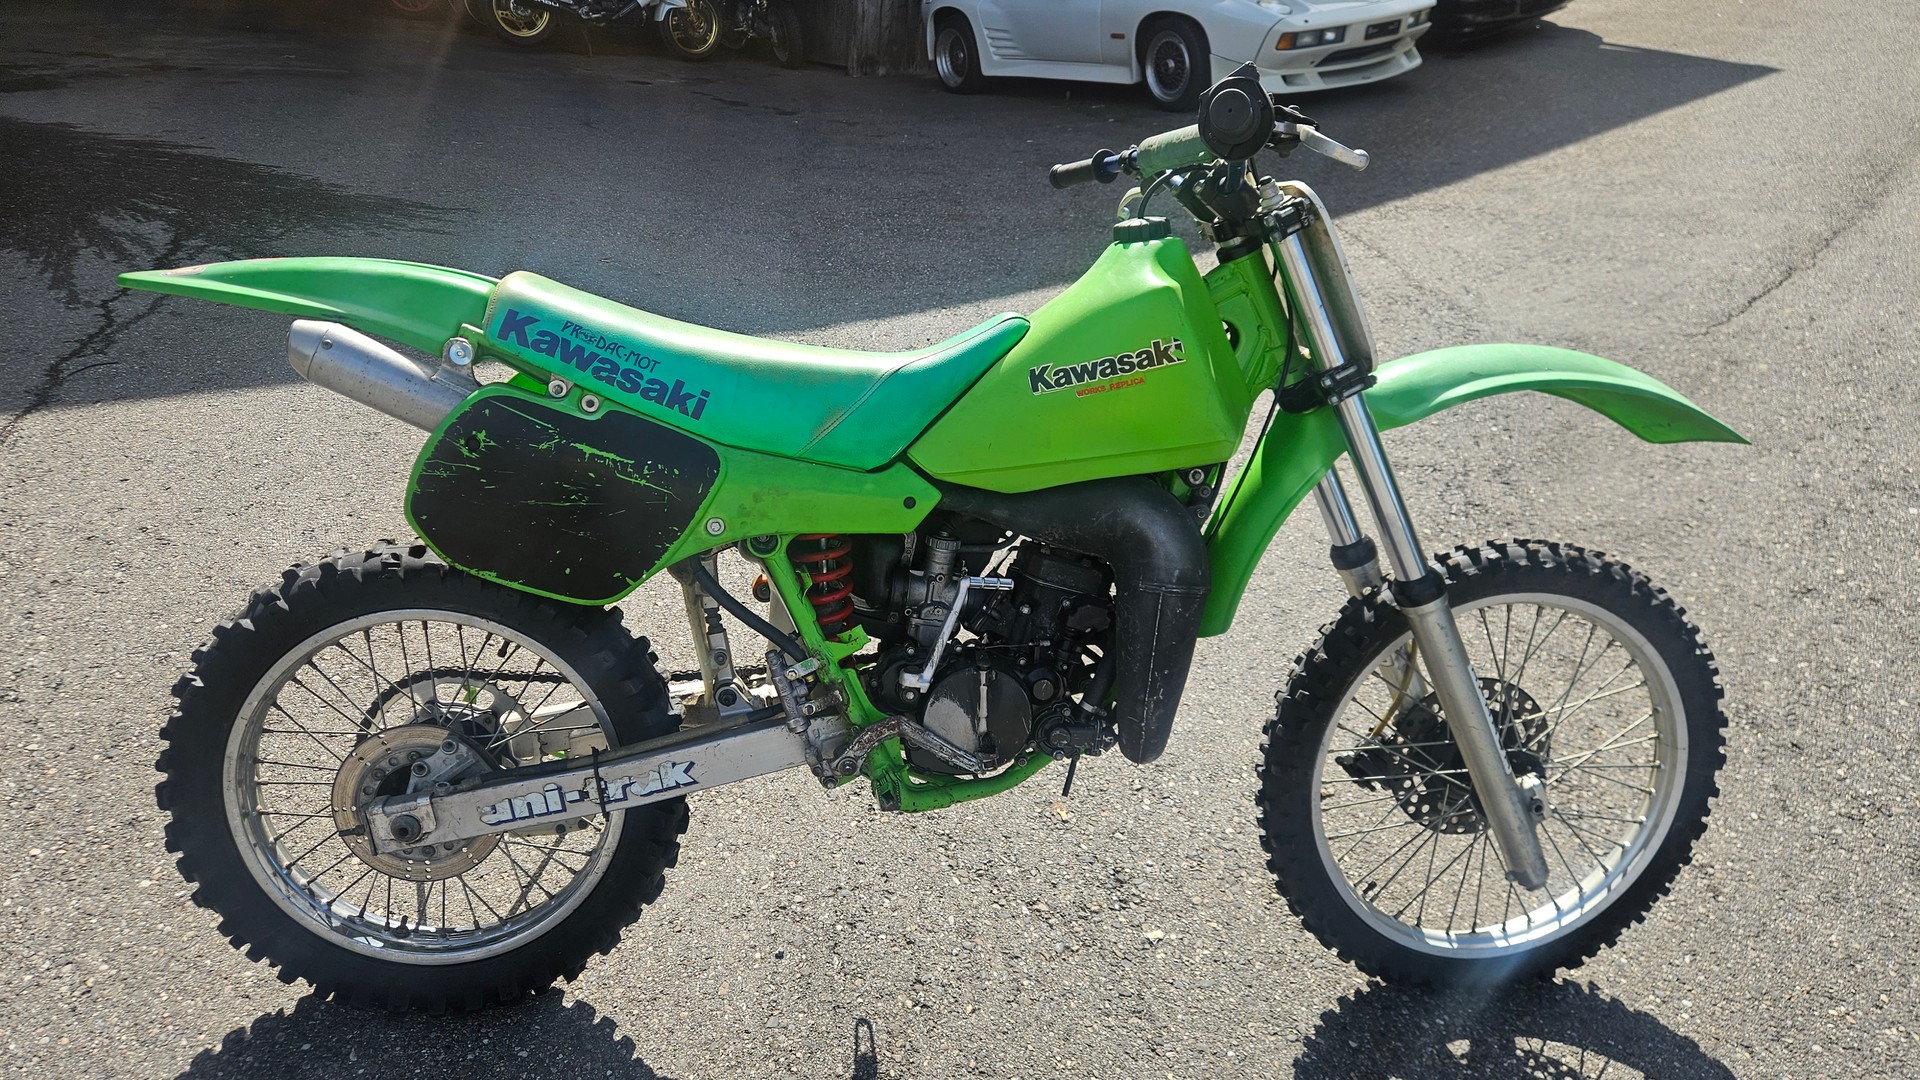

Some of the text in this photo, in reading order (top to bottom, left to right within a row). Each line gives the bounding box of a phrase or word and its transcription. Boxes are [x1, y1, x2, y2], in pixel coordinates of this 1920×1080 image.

[497, 309, 711, 421] Kawasaki
[1075, 377, 1145, 397] WORKS REPLICA
